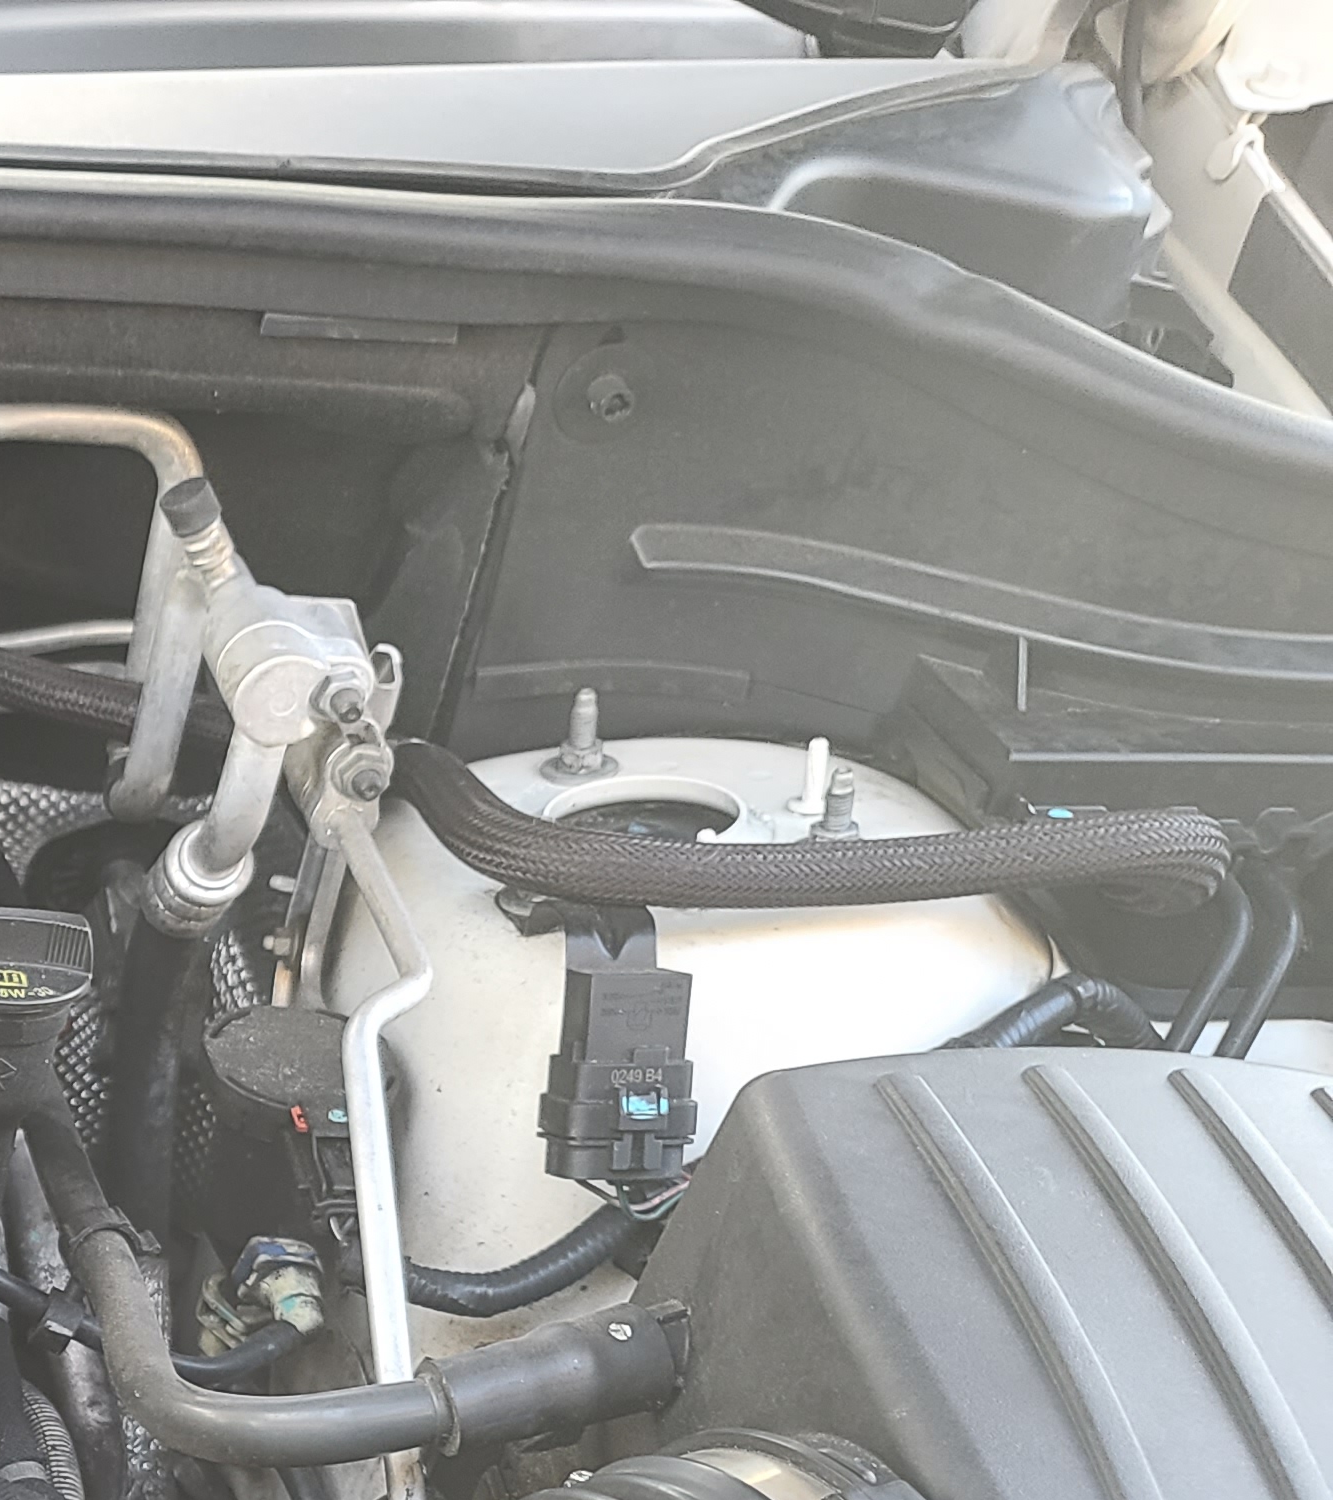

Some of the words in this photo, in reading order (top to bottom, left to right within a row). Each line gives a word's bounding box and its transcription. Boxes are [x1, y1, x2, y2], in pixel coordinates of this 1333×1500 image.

[0, 986, 55, 999] 5W-30
[610, 1068, 643, 1084] 0249
[645, 1067, 663, 1083] B4
